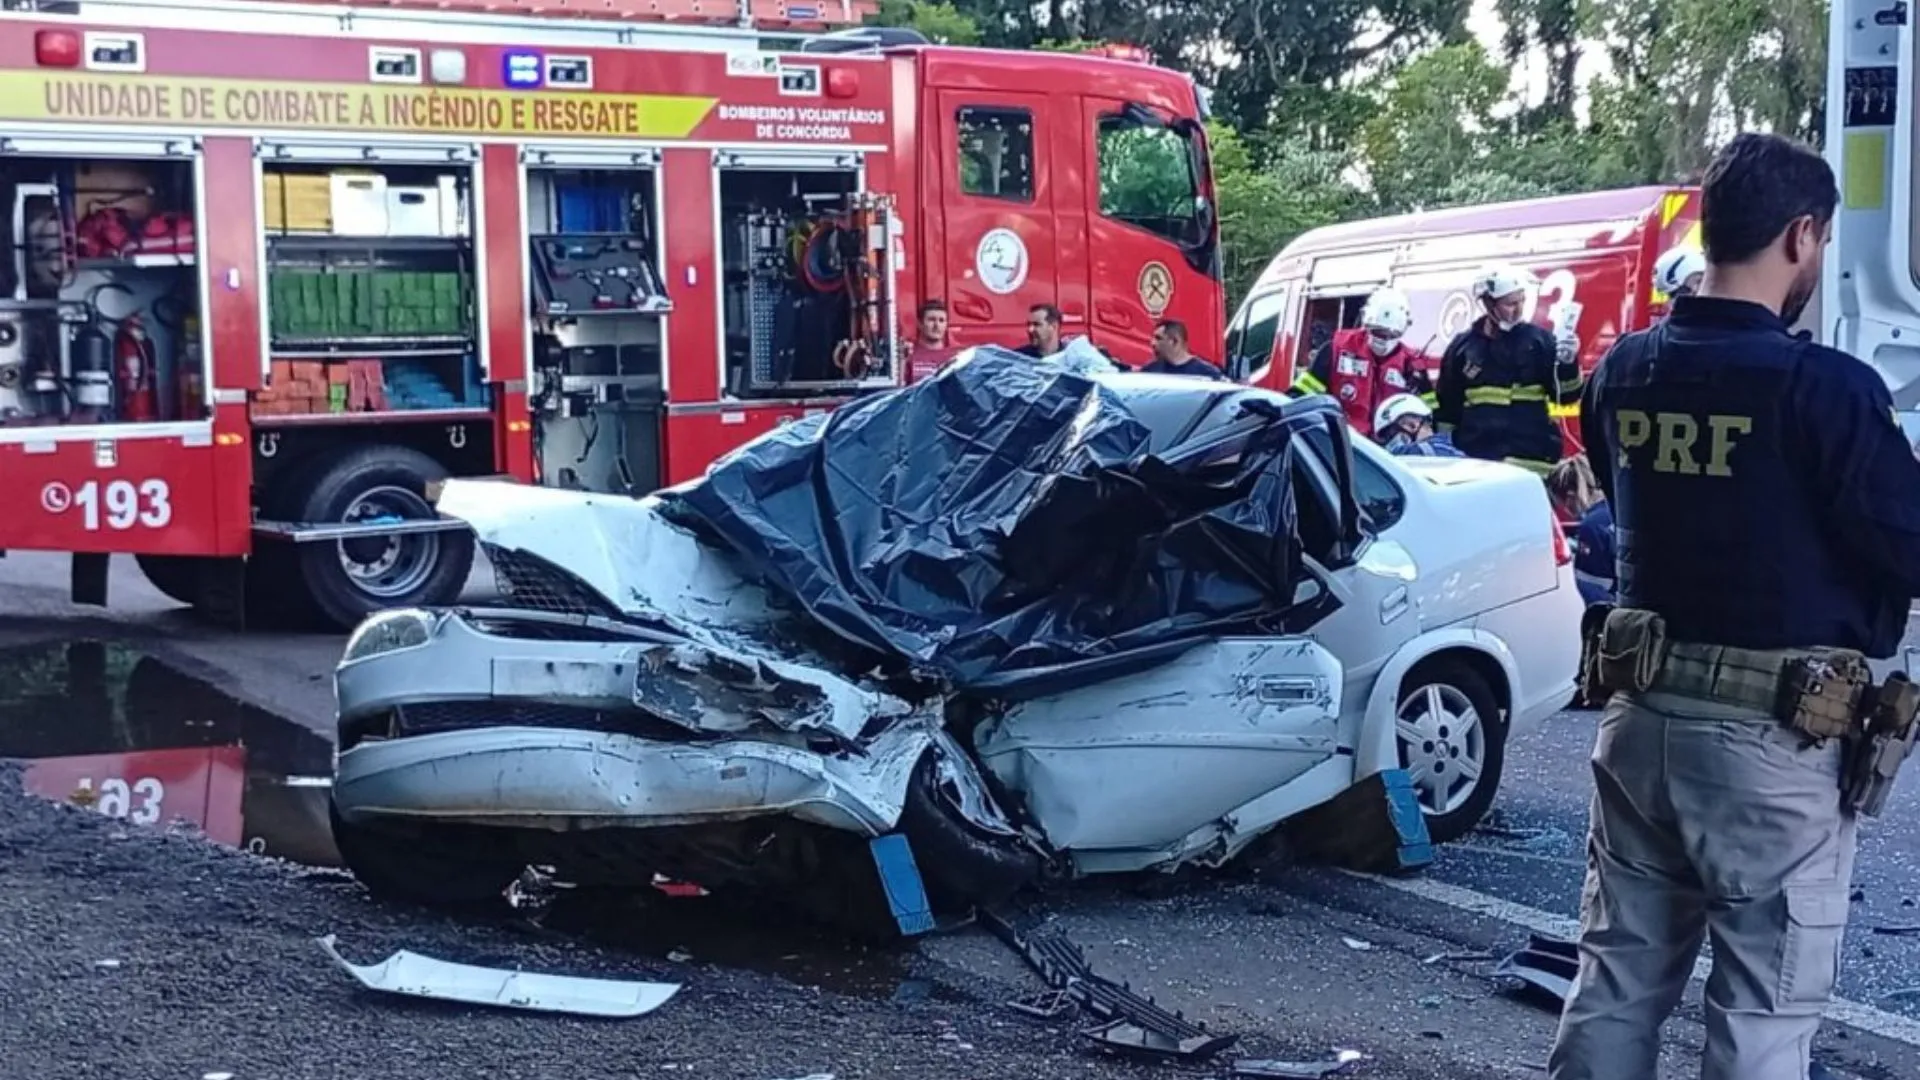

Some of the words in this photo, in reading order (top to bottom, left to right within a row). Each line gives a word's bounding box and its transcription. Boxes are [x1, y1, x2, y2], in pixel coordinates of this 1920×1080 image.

[44, 80, 171, 119] UNIDADE
[181, 87, 215, 120] DE
[225, 89, 349, 126] COMBATE
[359, 93, 375, 126] A
[385, 88, 502, 132] INCÊNDIO
[511, 99, 526, 130] E
[534, 100, 639, 133] RESGATE
[719, 105, 795, 121] BOMBEIROS
[798, 106, 885, 124] VOLUNTÁRIOS
[756, 124, 773, 138] DE
[777, 124, 851, 140] CONCÓRDIA
[1616, 409, 1752, 477] PRF
[75, 478, 171, 531] 193
